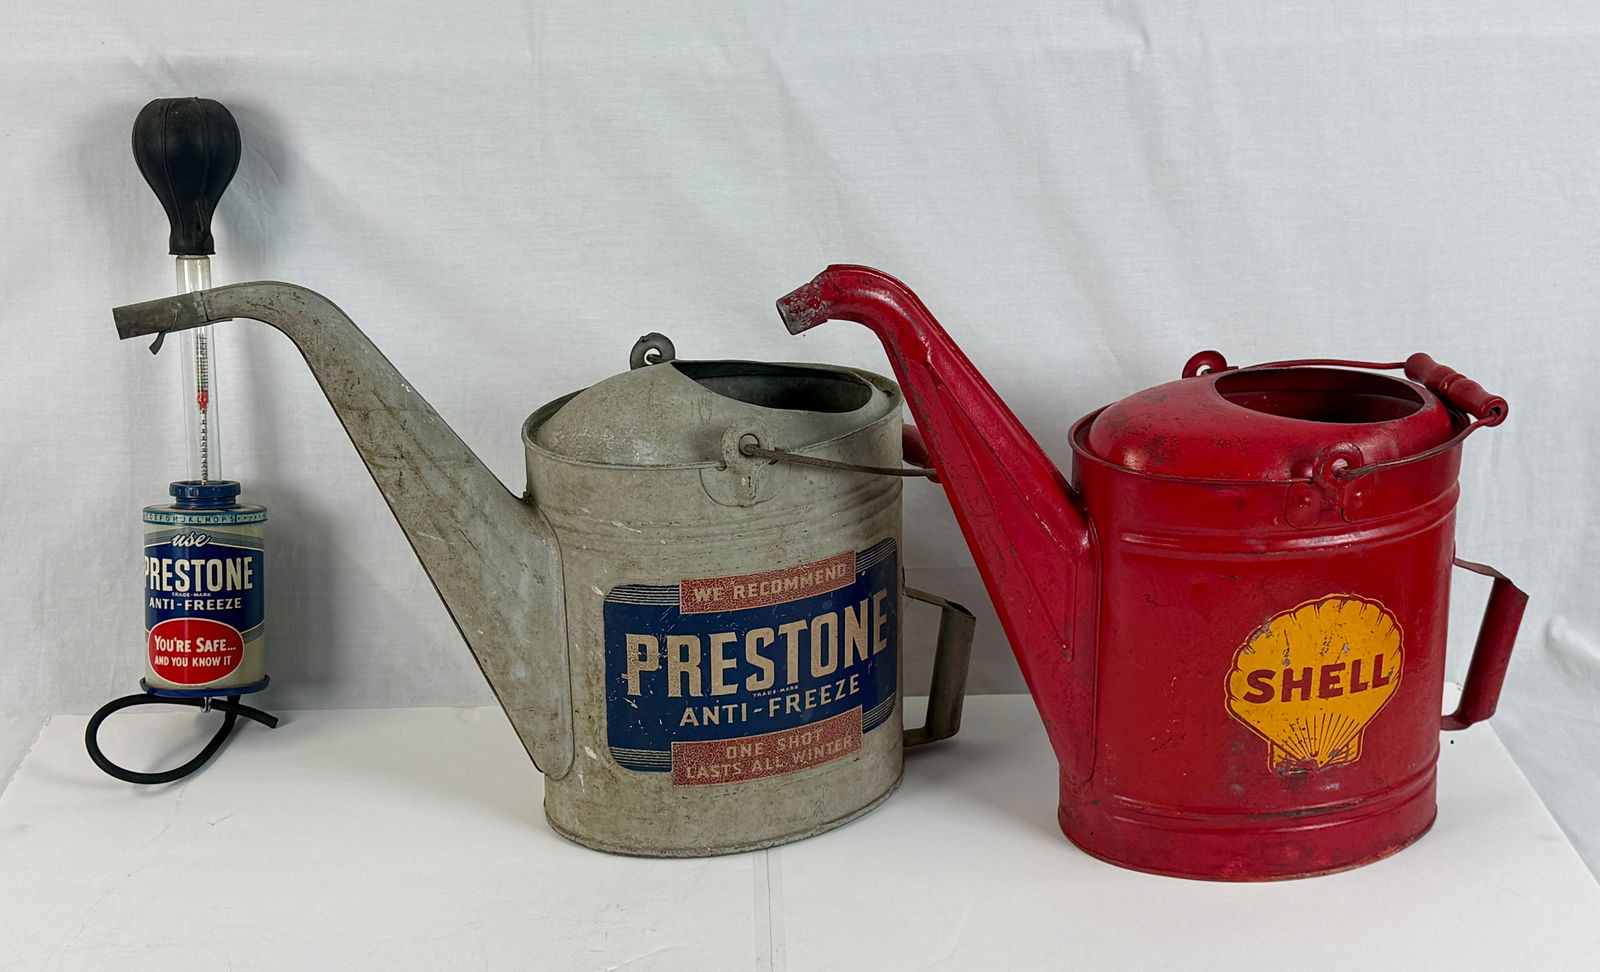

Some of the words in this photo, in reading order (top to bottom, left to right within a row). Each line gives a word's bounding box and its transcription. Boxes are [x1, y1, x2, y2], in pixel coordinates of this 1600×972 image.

[171, 531, 212, 547] use
[144, 555, 253, 592] PRESTONE
[693, 586, 724, 602] WE
[733, 564, 847, 600] RECOMMEND
[154, 635, 191, 652] YOU'RE
[154, 655, 169, 665] AND
[171, 657, 188, 667] YOU
[192, 656, 221, 667] KNOW
[223, 655, 232, 665] IT
[625, 588, 888, 698] PRESTONE
[1243, 653, 1391, 704] SHELL
[686, 762, 742, 779] LASTS
[751, 755, 785, 773] ALL
[791, 736, 853, 764] WINTER
[726, 744, 764, 760] ONE
[777, 728, 824, 752] SHOT
